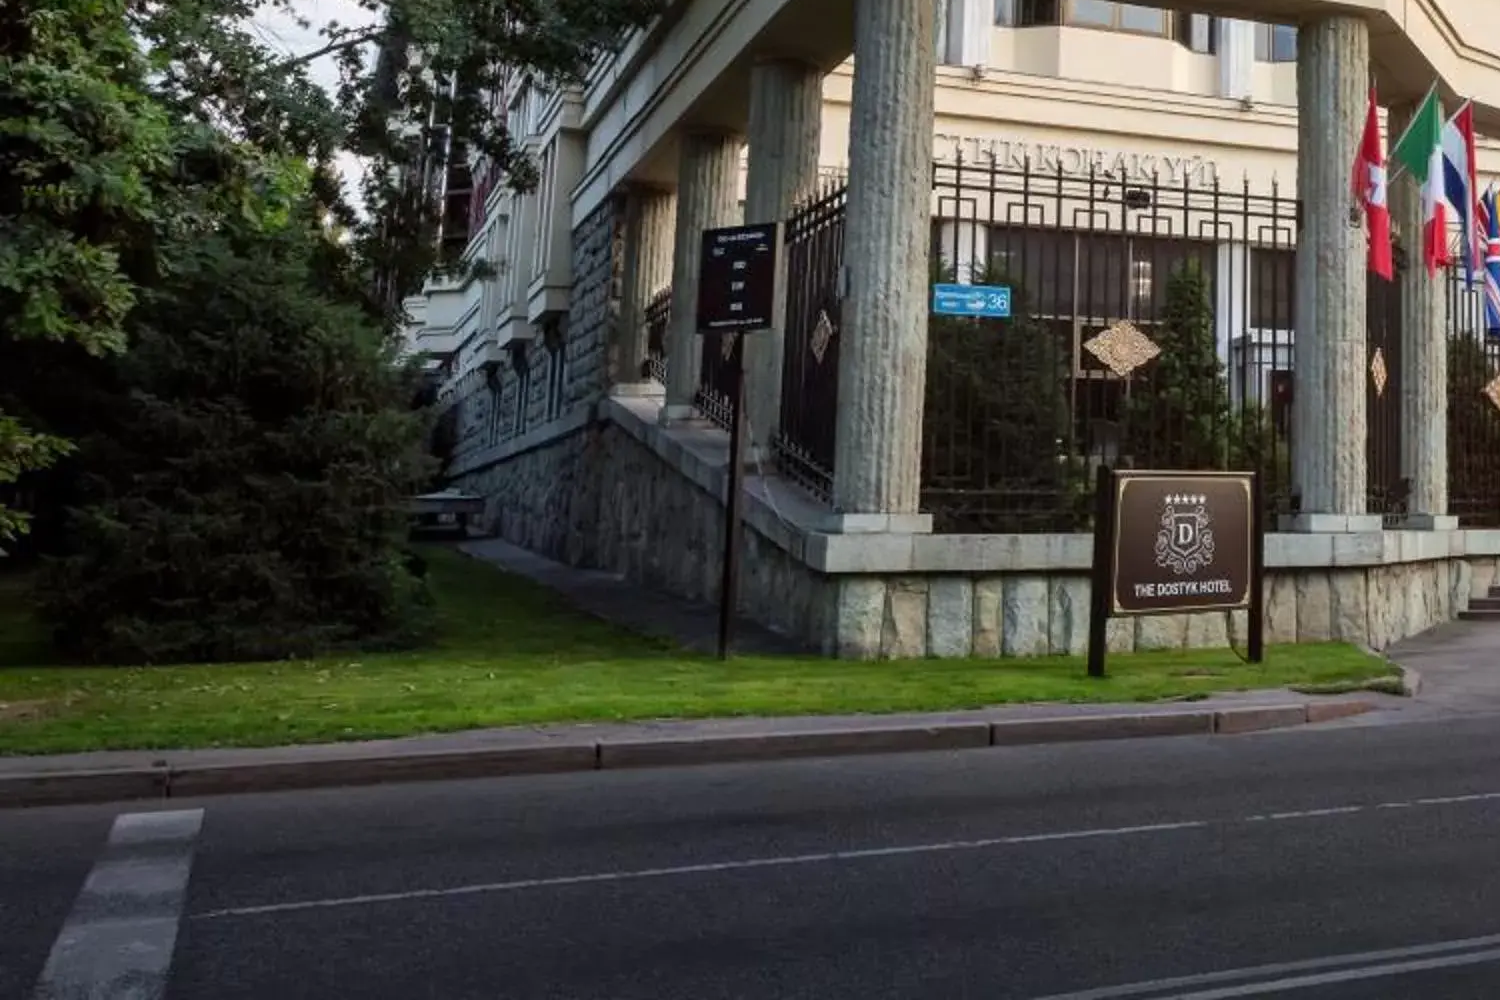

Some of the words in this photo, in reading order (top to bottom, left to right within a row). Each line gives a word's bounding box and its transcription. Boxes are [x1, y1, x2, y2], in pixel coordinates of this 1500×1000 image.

[987, 293, 1007, 310] 36
[1179, 523, 1193, 545] D
[1134, 583, 1155, 597] THE
[1157, 581, 1198, 596] DOSTYK
[1199, 579, 1232, 594] HOTEL
